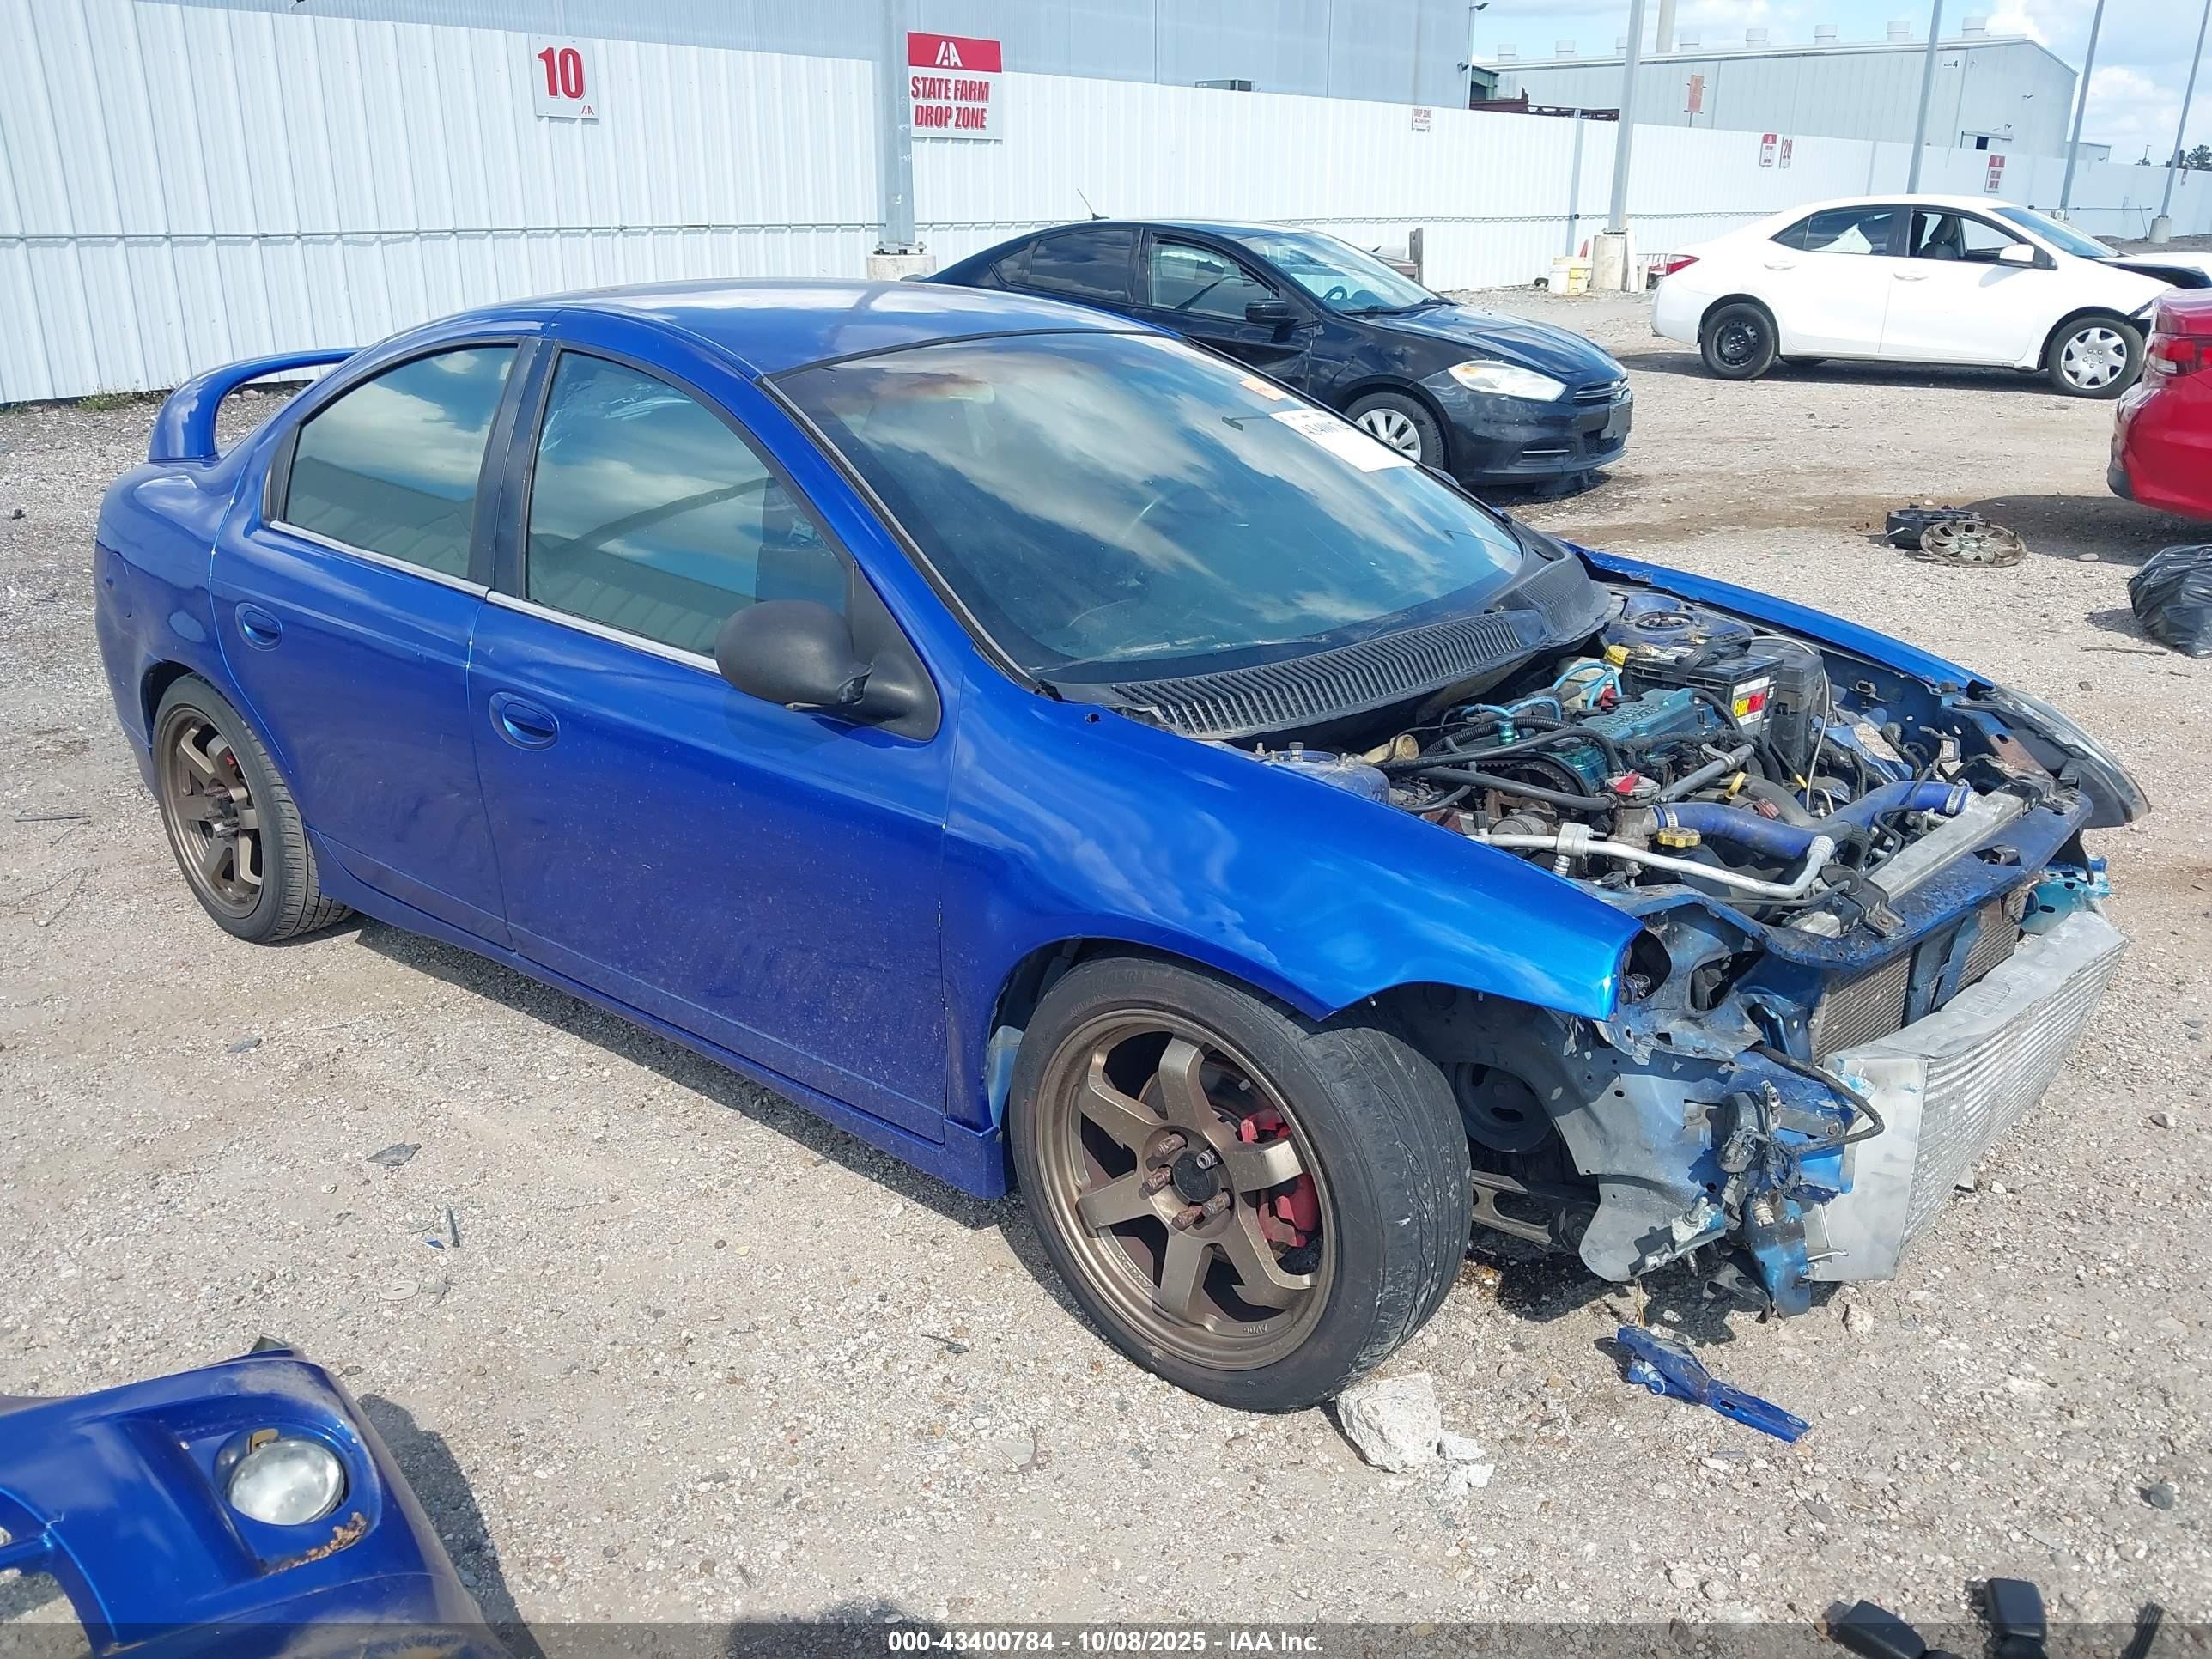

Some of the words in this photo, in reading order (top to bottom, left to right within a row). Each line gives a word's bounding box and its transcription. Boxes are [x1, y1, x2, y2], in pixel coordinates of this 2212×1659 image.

[536, 46, 586, 101] 10
[911, 76, 952, 100] STATE
[953, 78, 991, 103] FARM
[915, 104, 953, 129] DROP
[954, 106, 988, 131] ZONE
[1783, 139, 1793, 159] 20
